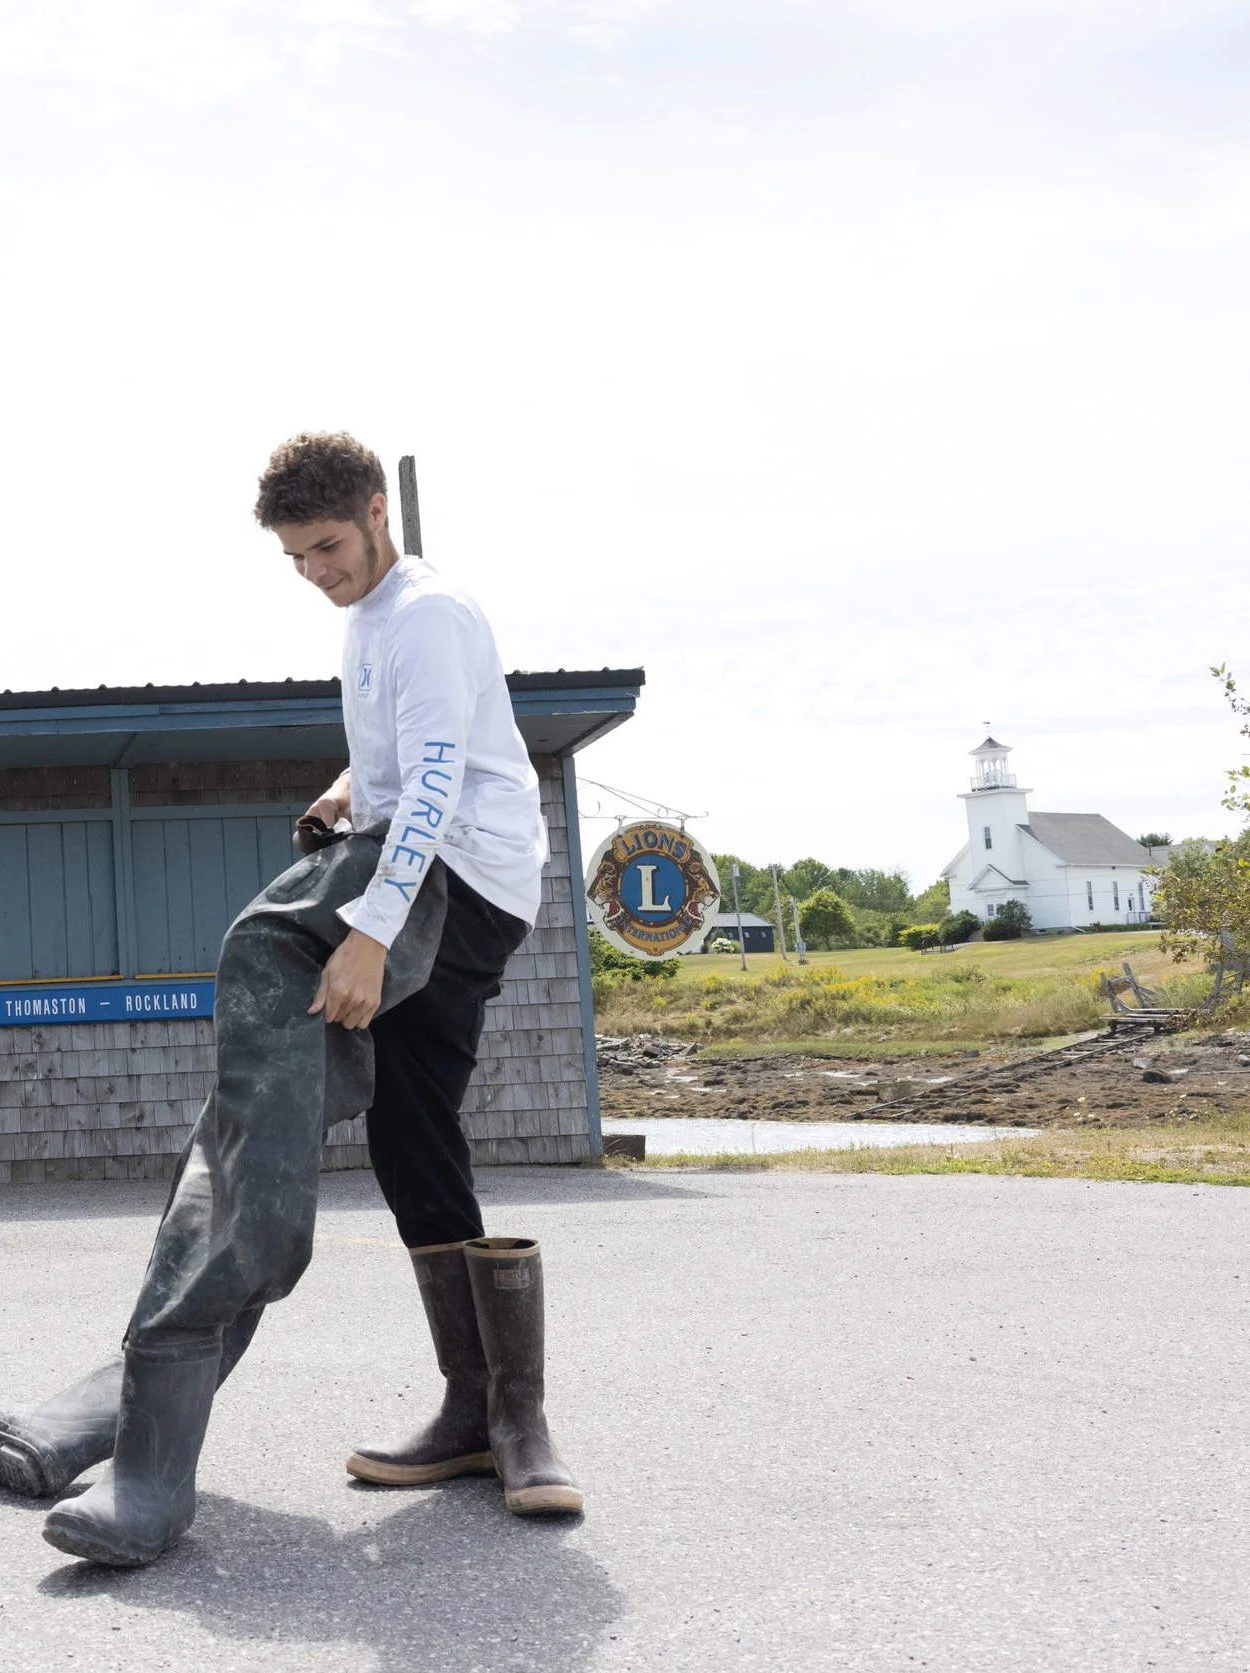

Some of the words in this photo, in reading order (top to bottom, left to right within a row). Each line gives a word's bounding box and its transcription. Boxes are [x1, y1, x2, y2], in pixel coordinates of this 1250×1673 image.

[384, 741, 456, 903] HURLEY
[621, 831, 687, 857] LIONS
[636, 865, 672, 911] L
[5, 997, 86, 1017] THOMASTON
[126, 993, 198, 1012] ROCKLAND
